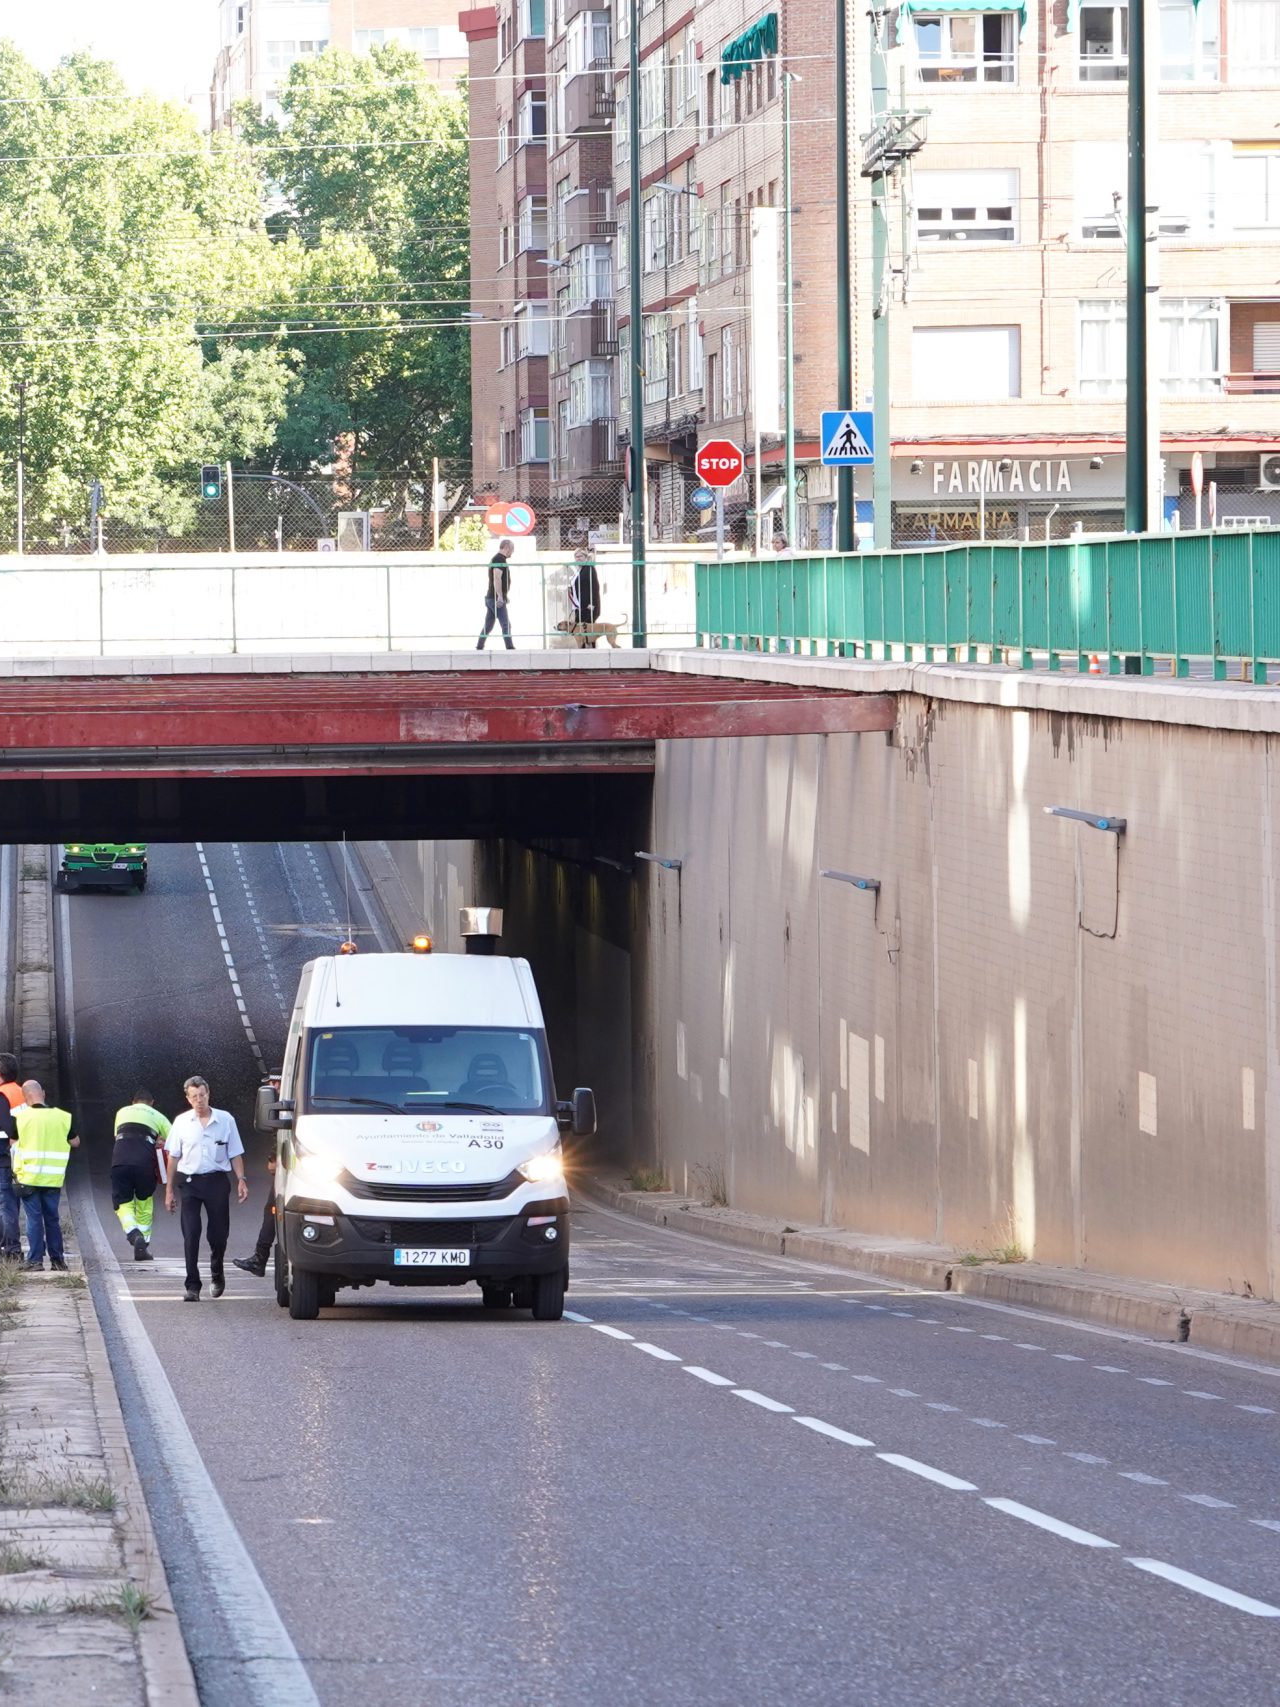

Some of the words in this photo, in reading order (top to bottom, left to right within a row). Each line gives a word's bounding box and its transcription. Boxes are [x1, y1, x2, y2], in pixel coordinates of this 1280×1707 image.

[701, 458, 739, 469] STOP
[933, 460, 1072, 494] FARMACIA
[467, 1140, 505, 1150] A30
[394, 1160, 466, 1173] IVECO
[405, 1251, 437, 1264] 1277
